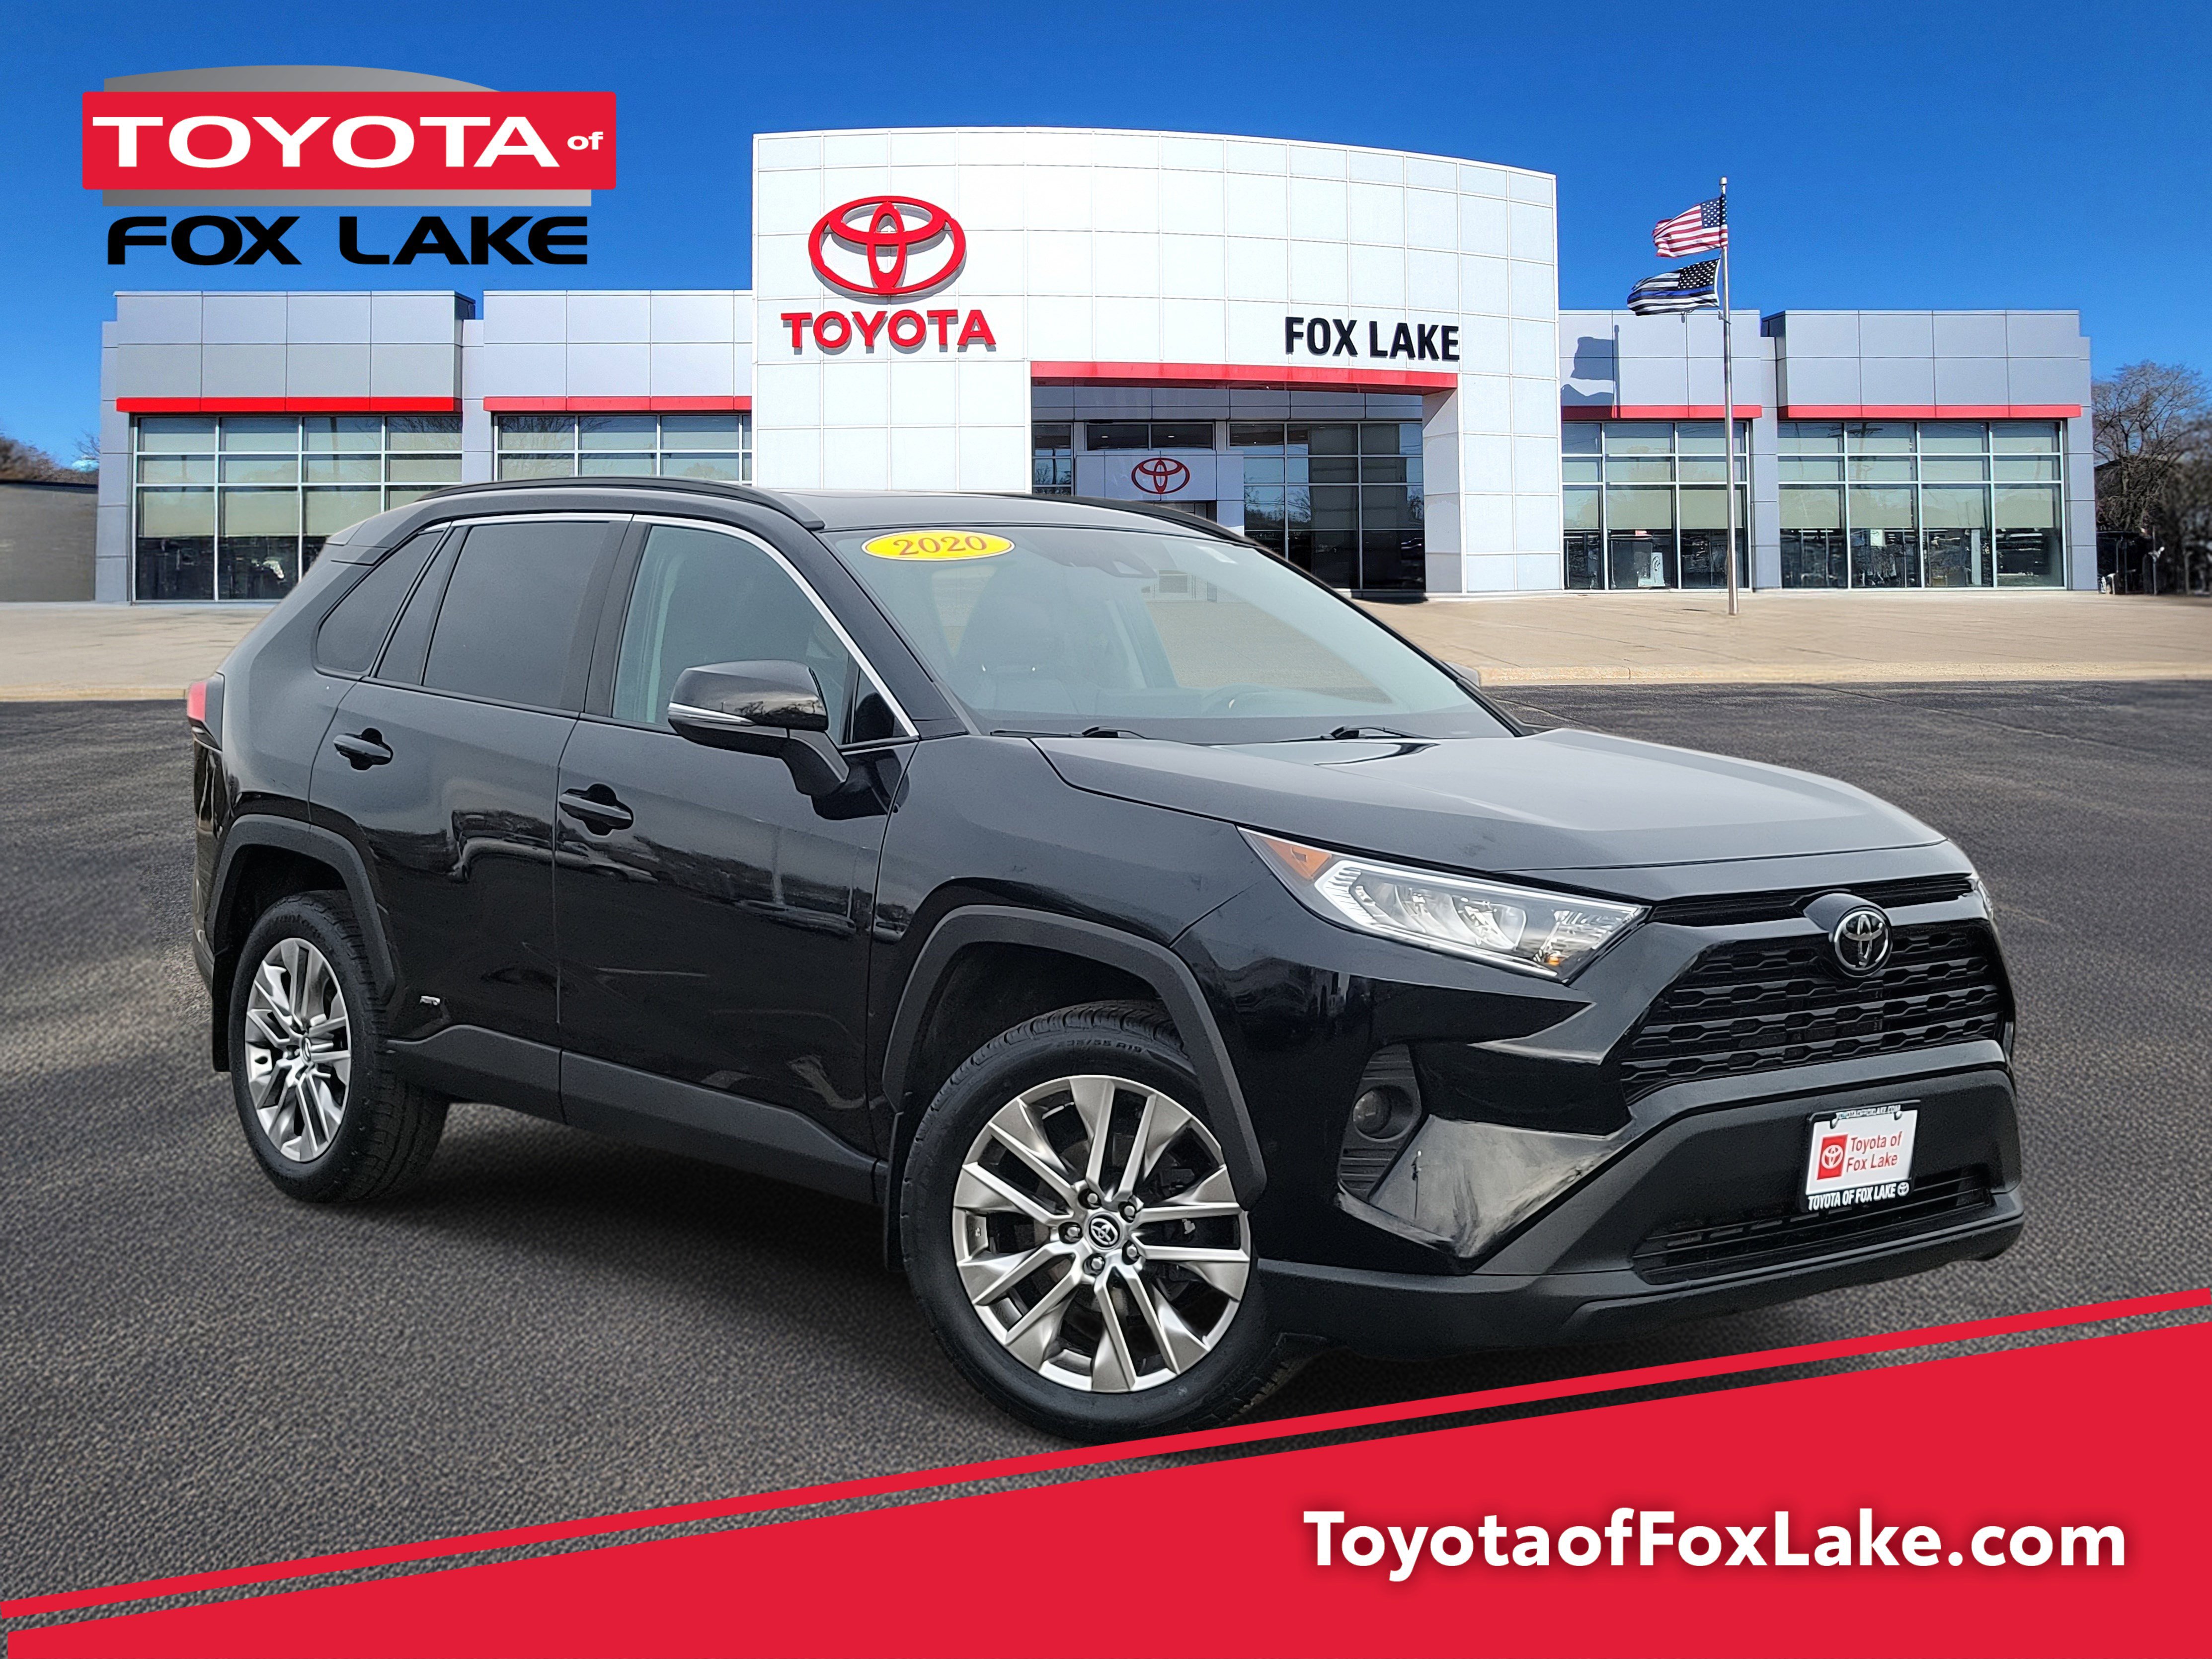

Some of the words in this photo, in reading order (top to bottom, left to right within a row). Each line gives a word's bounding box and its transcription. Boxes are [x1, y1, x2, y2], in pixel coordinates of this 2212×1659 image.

[781, 309, 997, 353] TOYOTA
[1285, 316, 1358, 357] FOX
[1369, 320, 1460, 361] LAKE
[893, 535, 987, 556] 2020
[1850, 1134, 1887, 1155] Toyota
[1890, 1131, 1903, 1147] of
[1846, 1157, 1867, 1173] Fox
[1870, 1152, 1898, 1169] Lake
[1808, 1194, 1841, 1211] TOYOTA
[1842, 1191, 1855, 1205] OF
[1855, 1187, 1873, 1203] FOX
[1873, 1183, 1896, 1200] LAKE
